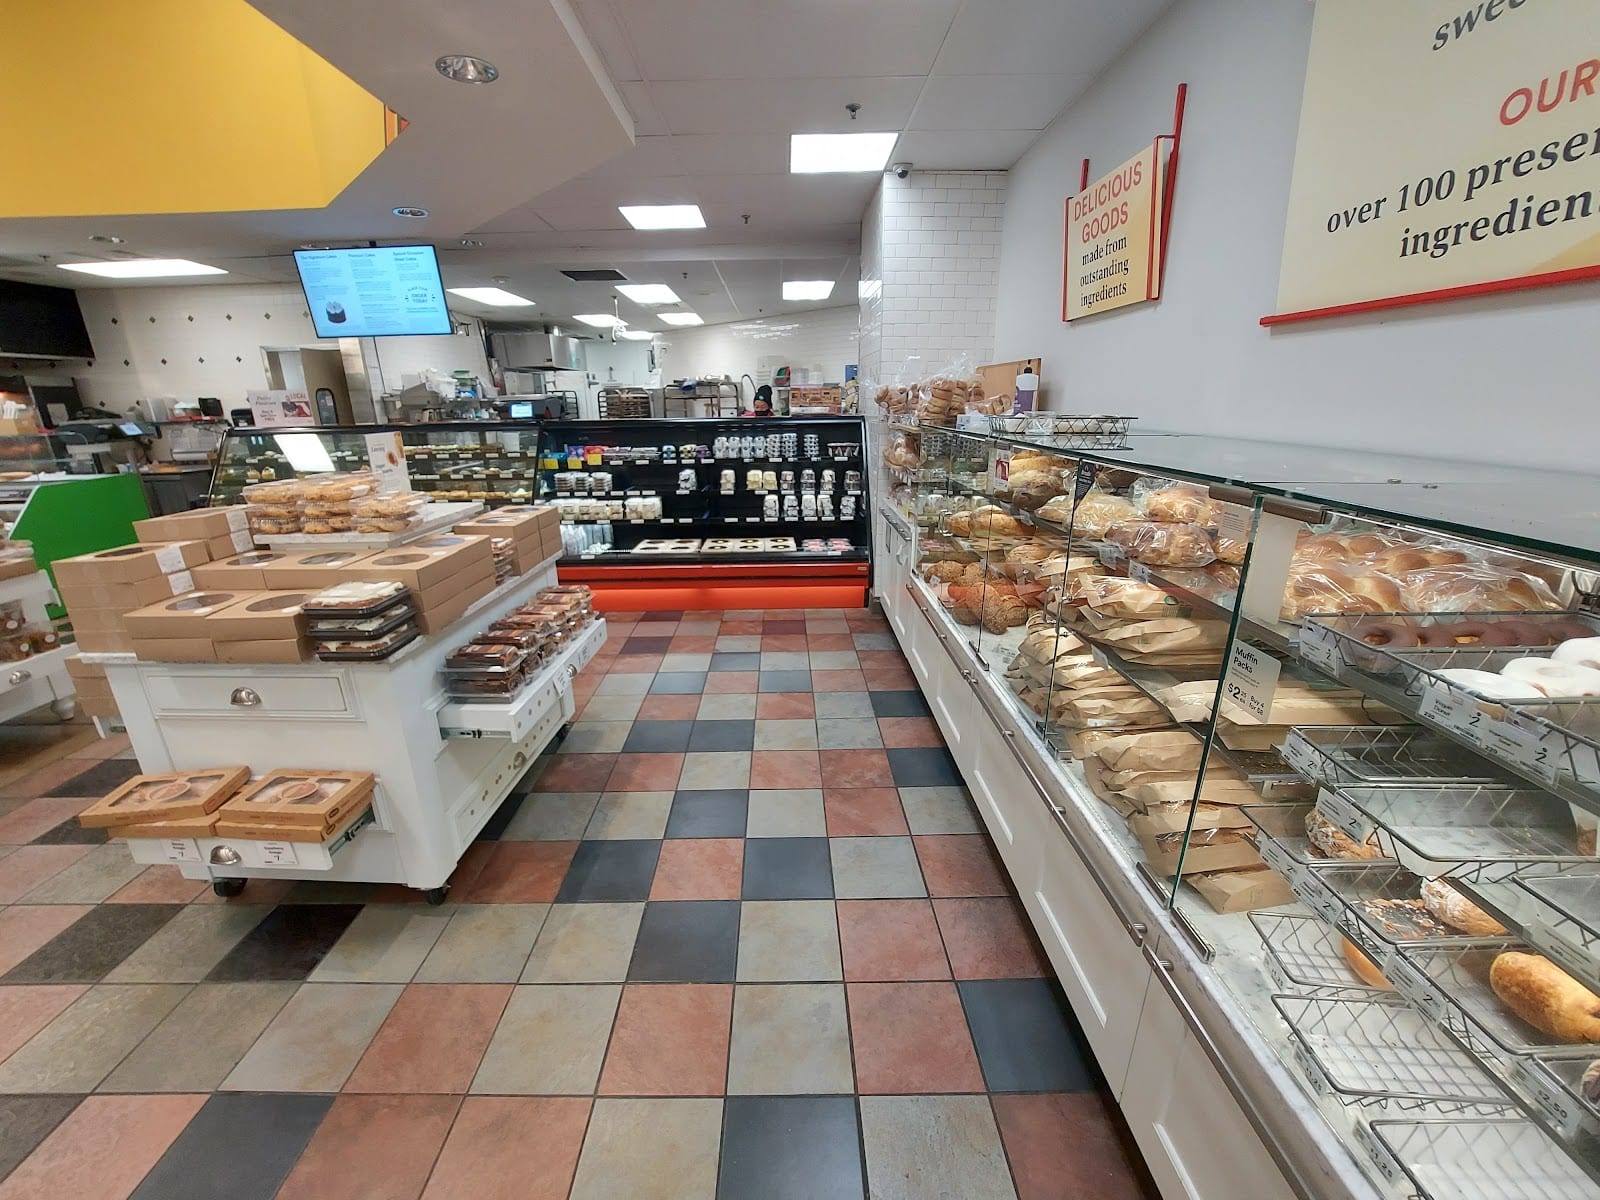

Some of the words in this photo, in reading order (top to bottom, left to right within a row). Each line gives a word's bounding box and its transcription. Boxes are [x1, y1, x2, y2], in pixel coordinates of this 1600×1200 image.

[1499, 58, 1600, 126] OUR
[1074, 161, 1143, 222] DELICIOUS
[1327, 196, 1387, 233] over
[1397, 169, 1456, 213] 100
[1082, 202, 1129, 244] GOODS
[1399, 189, 1600, 259] ingredien
[1082, 244, 1108, 266] made
[1105, 236, 1127, 255] from
[1080, 258, 1129, 287] outstanding
[1080, 282, 1127, 308] ingredients
[1233, 657, 1253, 673] Packs
[1235, 647, 1258, 665] Muffin
[1248, 703, 1257, 711] for
[1250, 695, 1260, 706] Buy
